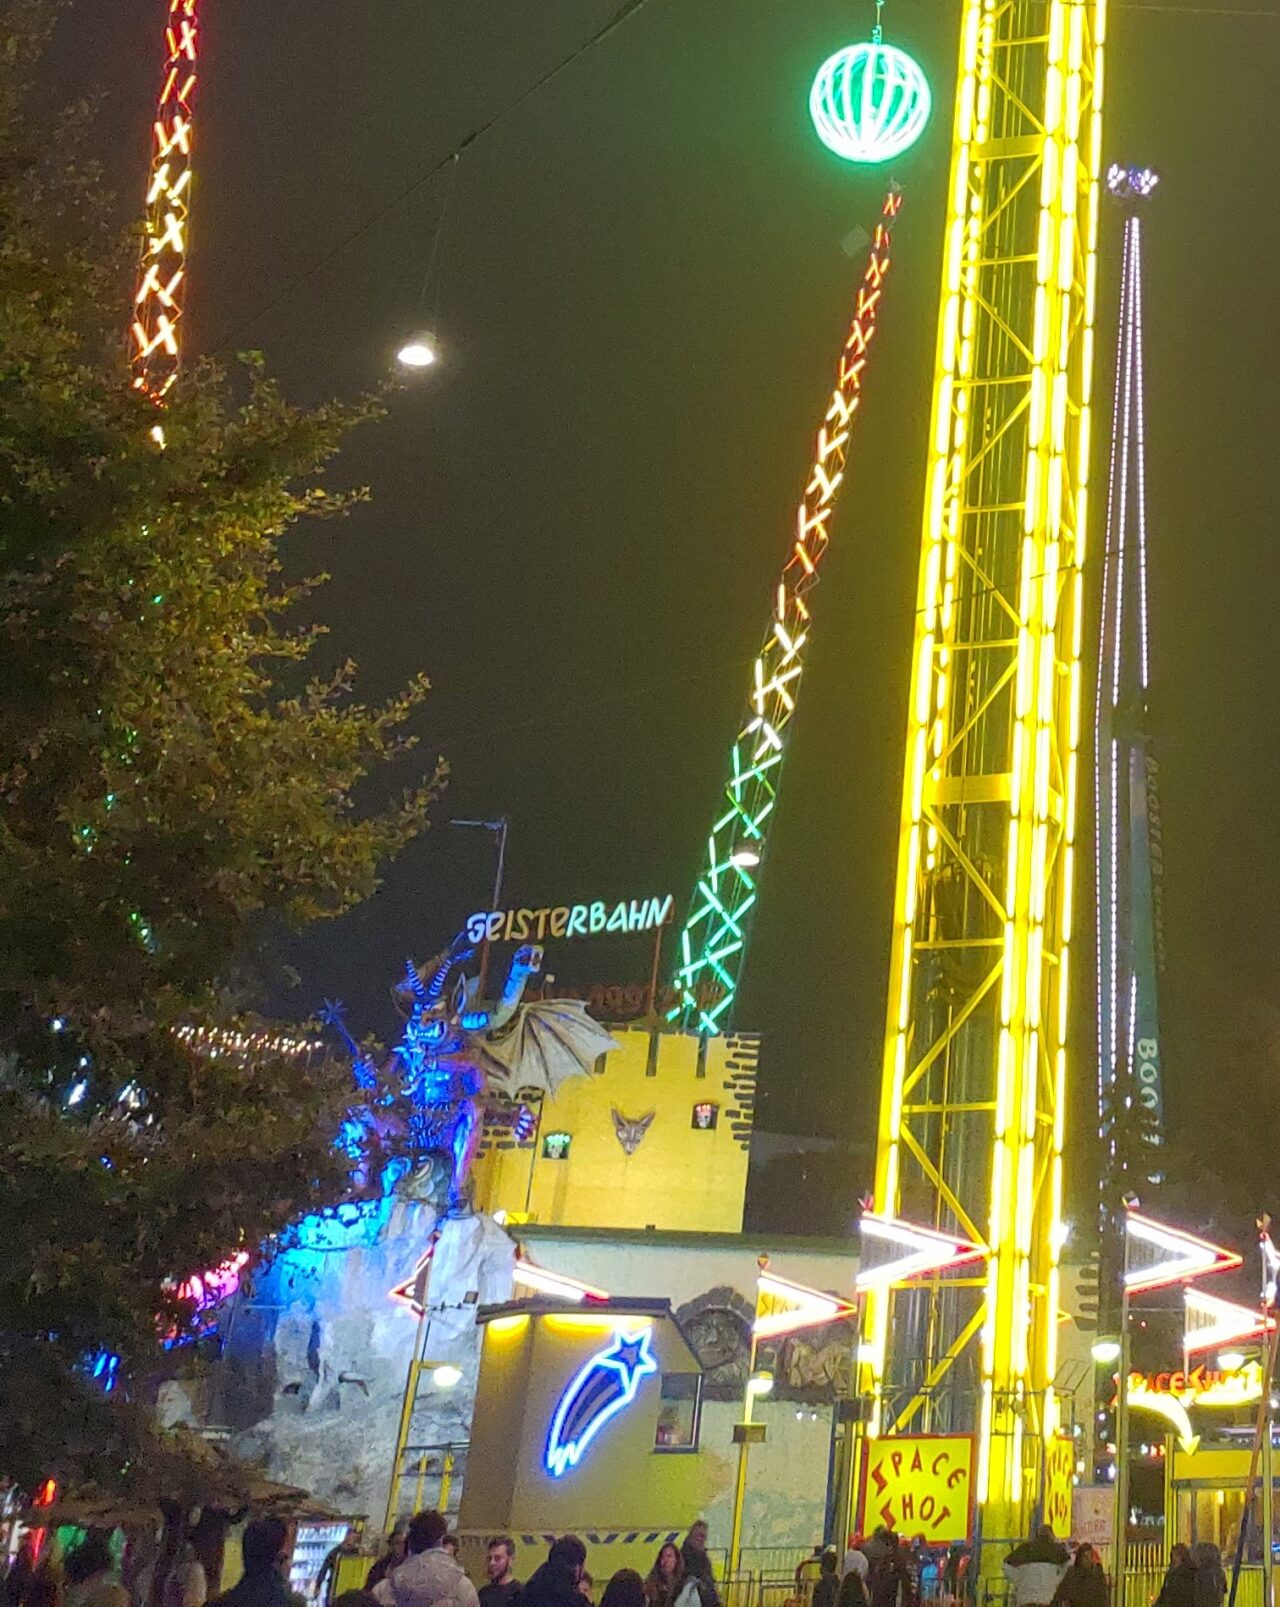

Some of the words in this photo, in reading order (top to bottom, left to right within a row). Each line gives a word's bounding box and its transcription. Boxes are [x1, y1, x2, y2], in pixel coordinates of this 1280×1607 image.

[467, 894, 673, 943] GEISTERBAHN
[871, 1445, 967, 1497] SPACE
[880, 1494, 951, 1532] SHOT
